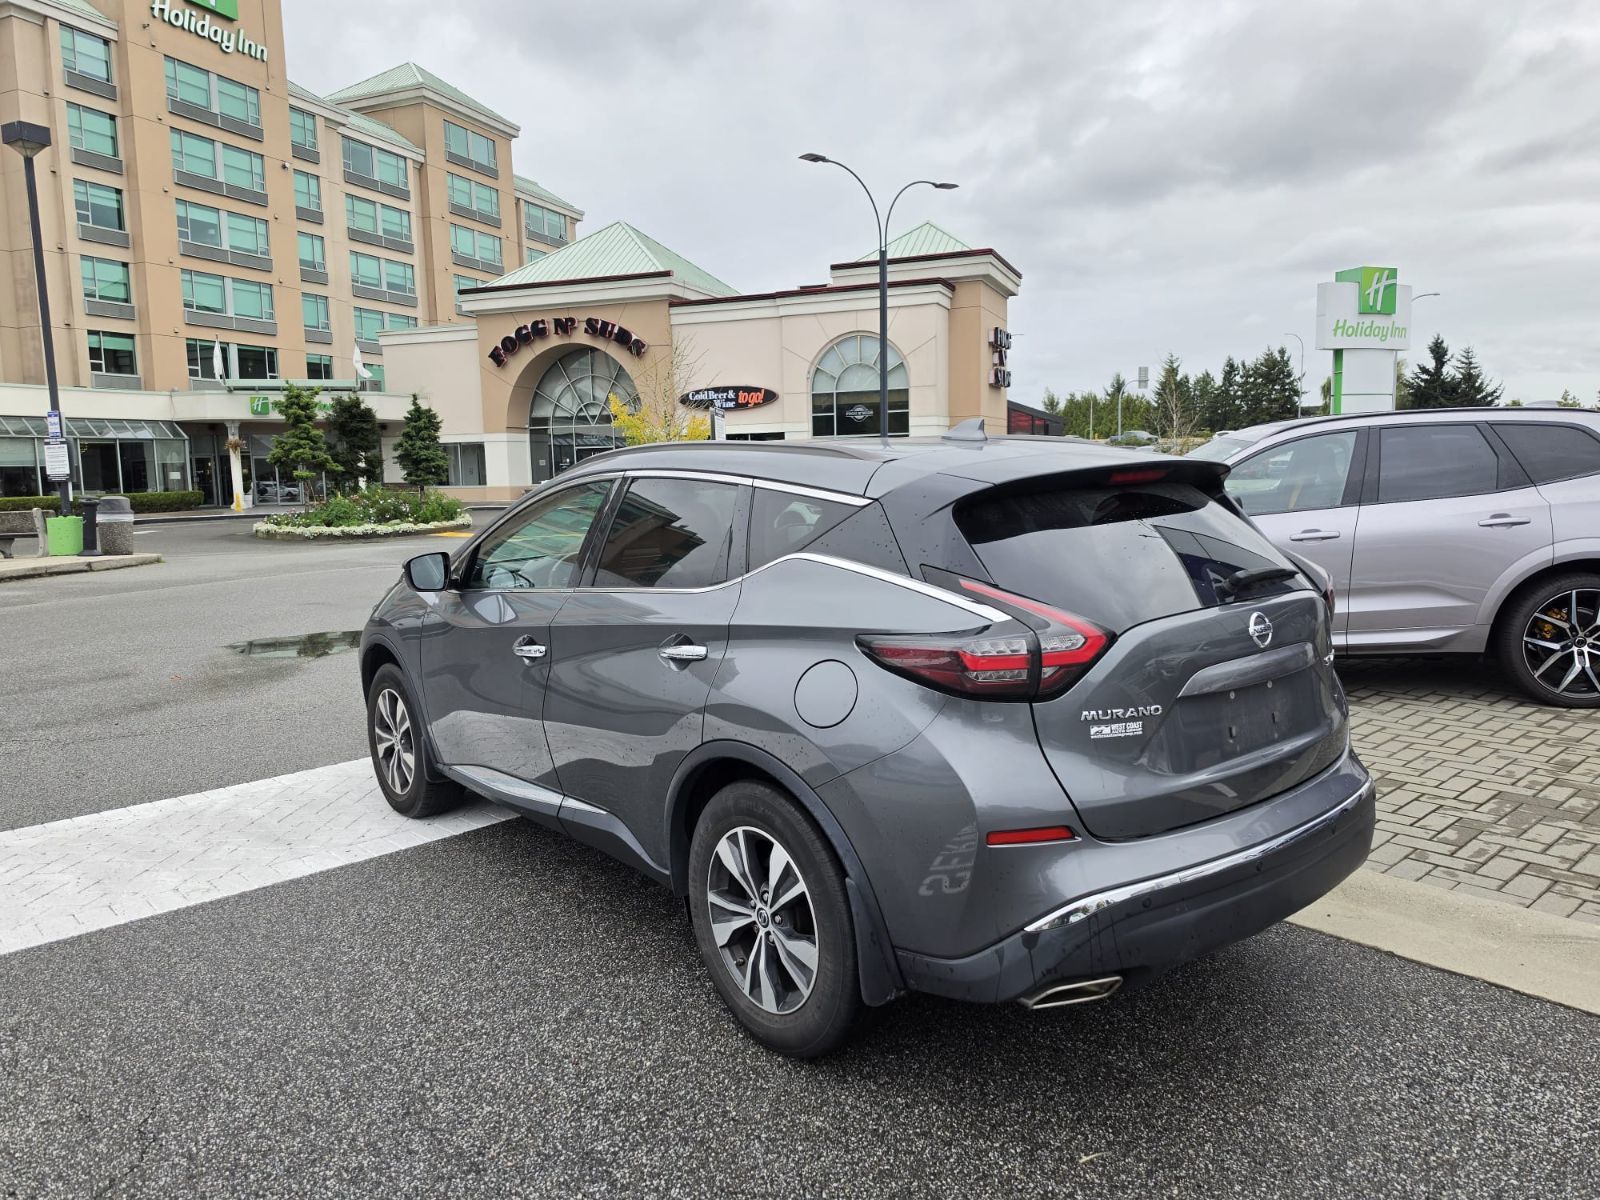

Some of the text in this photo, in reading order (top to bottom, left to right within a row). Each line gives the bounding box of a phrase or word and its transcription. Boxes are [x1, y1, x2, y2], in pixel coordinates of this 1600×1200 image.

[151, 0, 268, 62] Holiday Inn
[1333, 319, 1407, 342] Holiday Inn
[488, 319, 548, 367] FOGG
[583, 316, 648, 357] SUDS
[688, 391, 708, 401] Cold
[708, 391, 727, 400] Beer
[713, 399, 735, 409] Wine
[737, 388, 765, 407] to go!
[1080, 704, 1163, 721] MURANO
[1111, 722, 1126, 731] WEST
[1126, 721, 1143, 729] COAST
